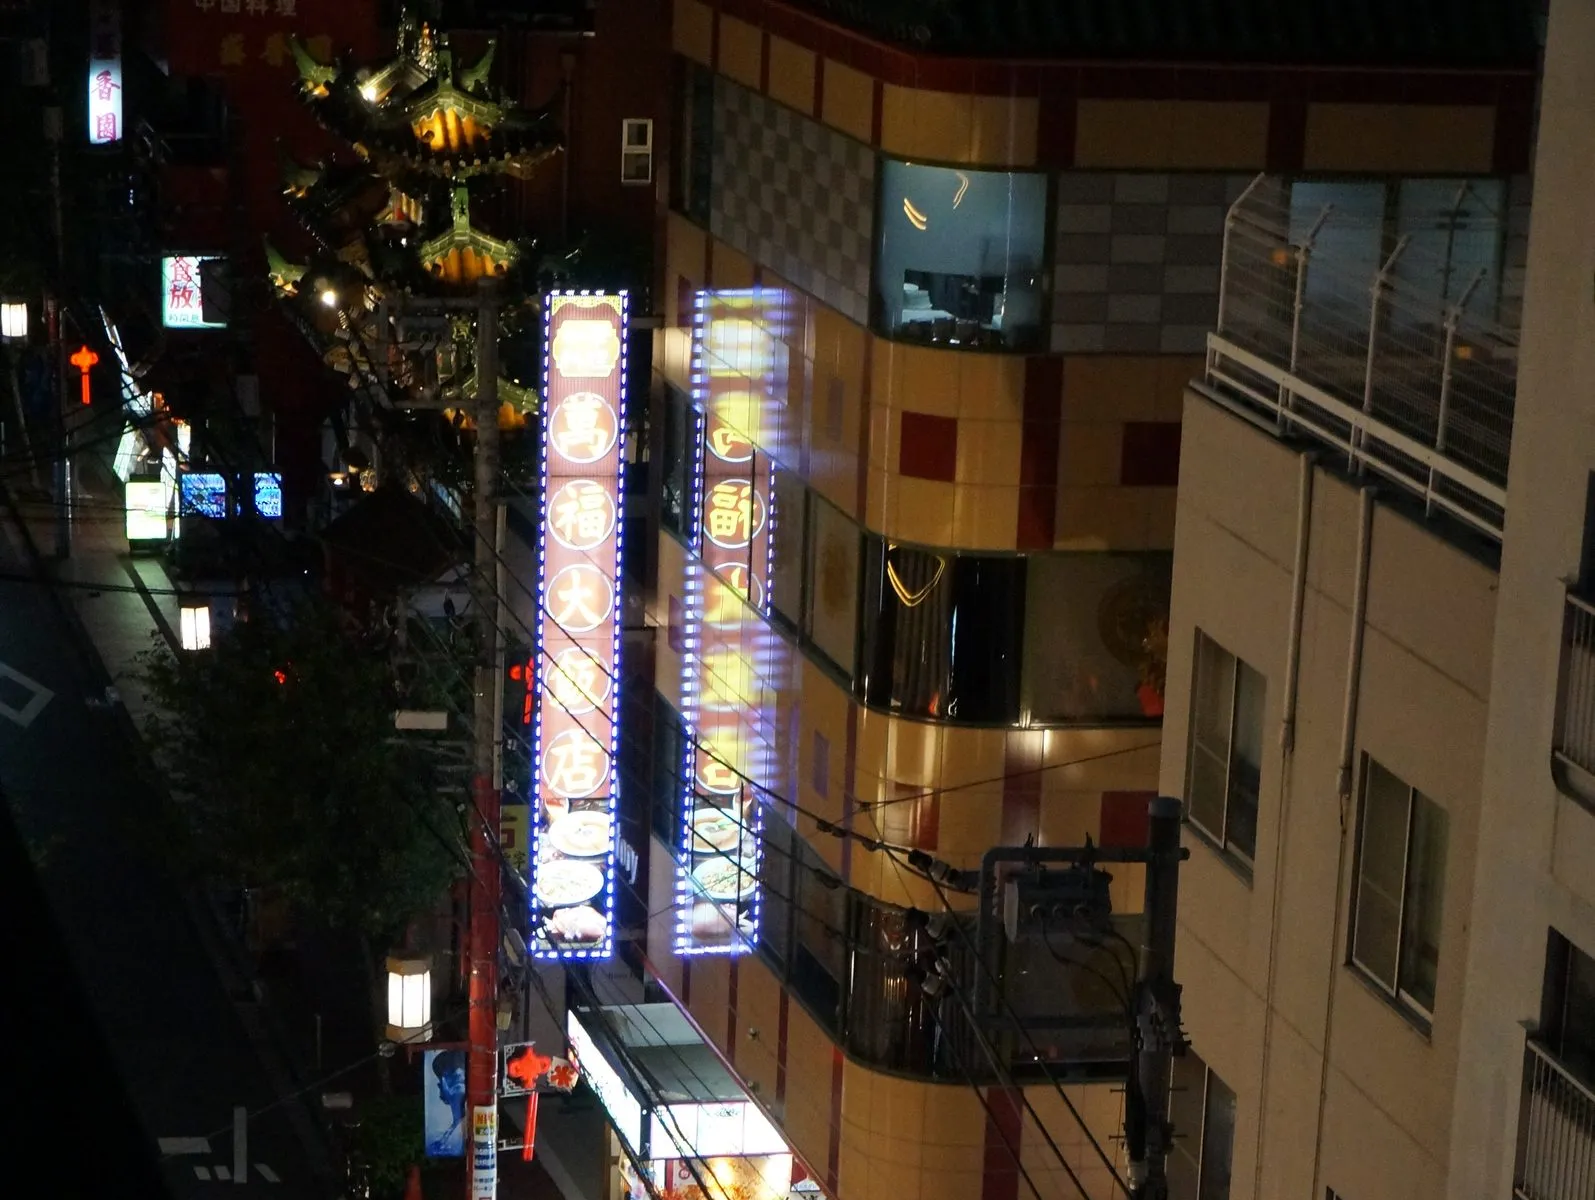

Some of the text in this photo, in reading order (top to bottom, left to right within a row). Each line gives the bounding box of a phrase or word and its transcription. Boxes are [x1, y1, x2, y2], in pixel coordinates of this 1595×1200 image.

[546, 393, 612, 793] 萬福大飯店
